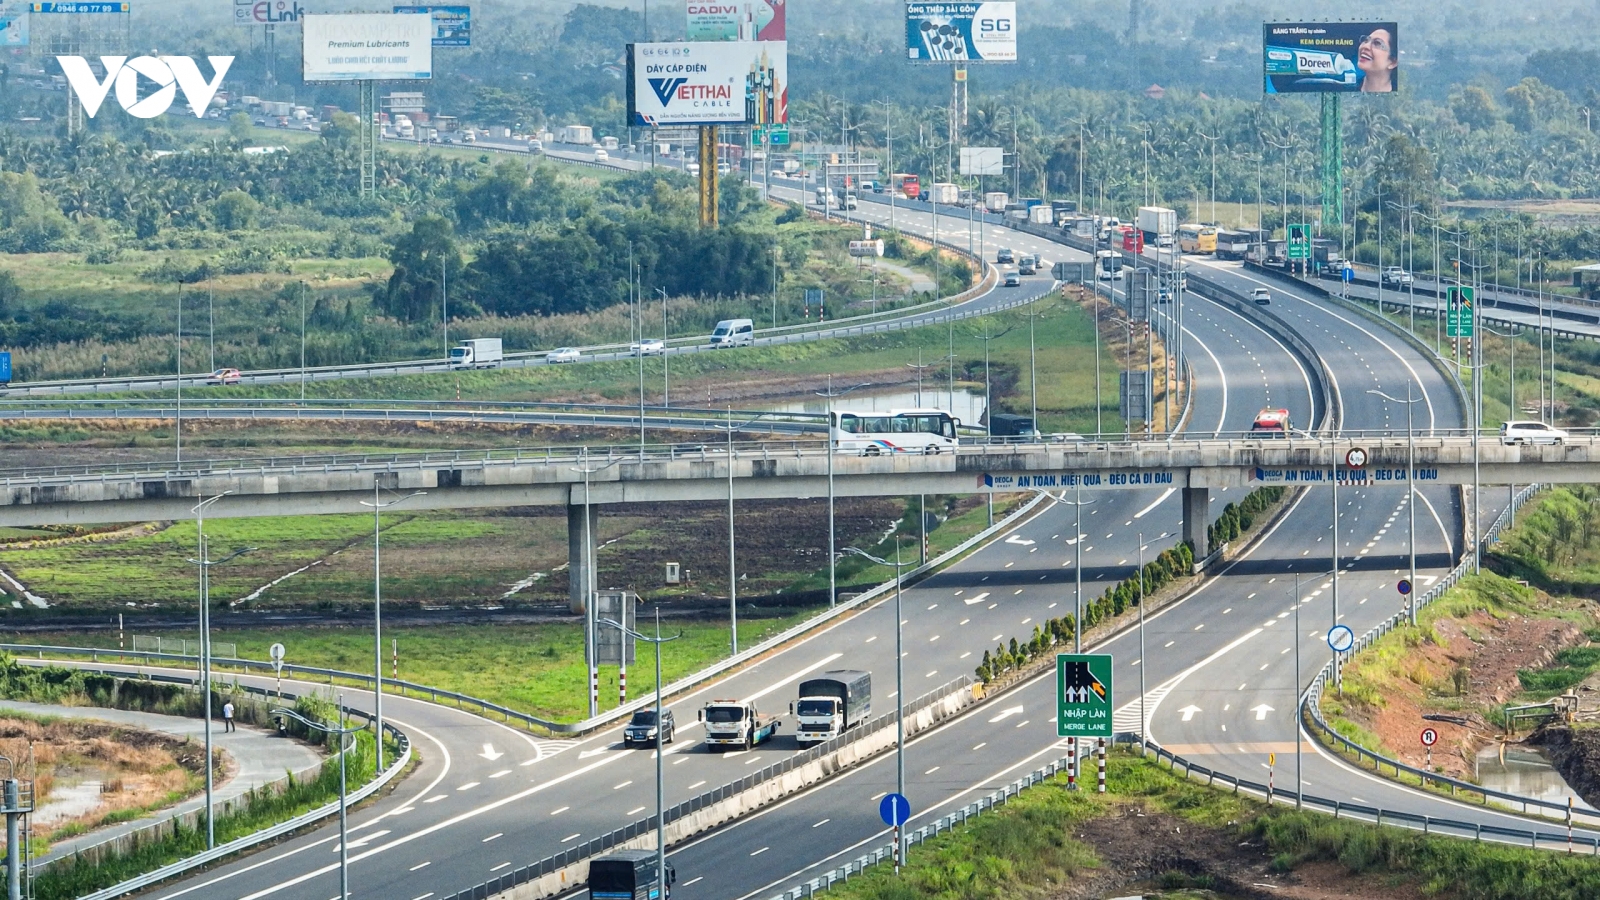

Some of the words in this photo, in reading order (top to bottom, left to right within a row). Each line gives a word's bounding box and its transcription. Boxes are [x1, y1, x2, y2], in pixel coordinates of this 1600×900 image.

[981, 19, 1010, 31] SG
[1300, 57, 1330, 68] Doreen
[647, 64, 664, 73] DÂY
[666, 64, 683, 72] CÁP
[686, 63, 706, 74] ĐIỆN
[1285, 470, 1297, 481] AN
[1018, 476, 1030, 487] AN
[1064, 708, 1086, 719] NHẬP
[1089, 708, 1106, 718] LÀN
